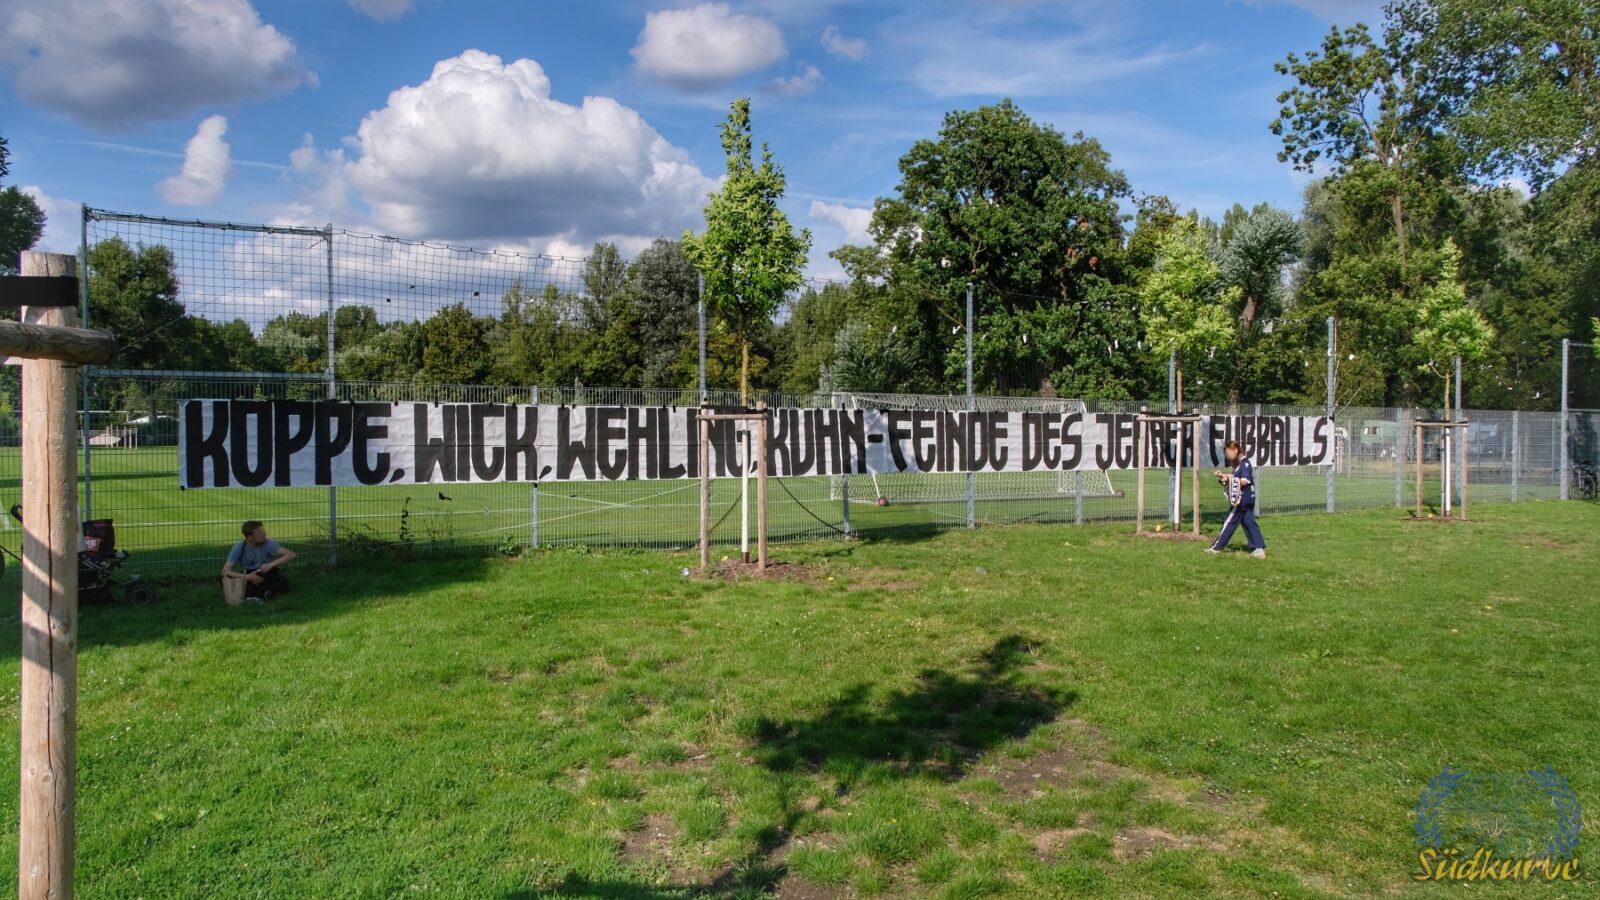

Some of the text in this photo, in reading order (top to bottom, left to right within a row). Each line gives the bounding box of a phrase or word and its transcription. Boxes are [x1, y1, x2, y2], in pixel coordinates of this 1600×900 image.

[185, 400, 405, 487] KOPPE,
[414, 403, 552, 482] WICK,
[556, 405, 759, 479] WEHLING,
[888, 410, 1008, 472] FEINDE
[1022, 412, 1082, 470] DES
